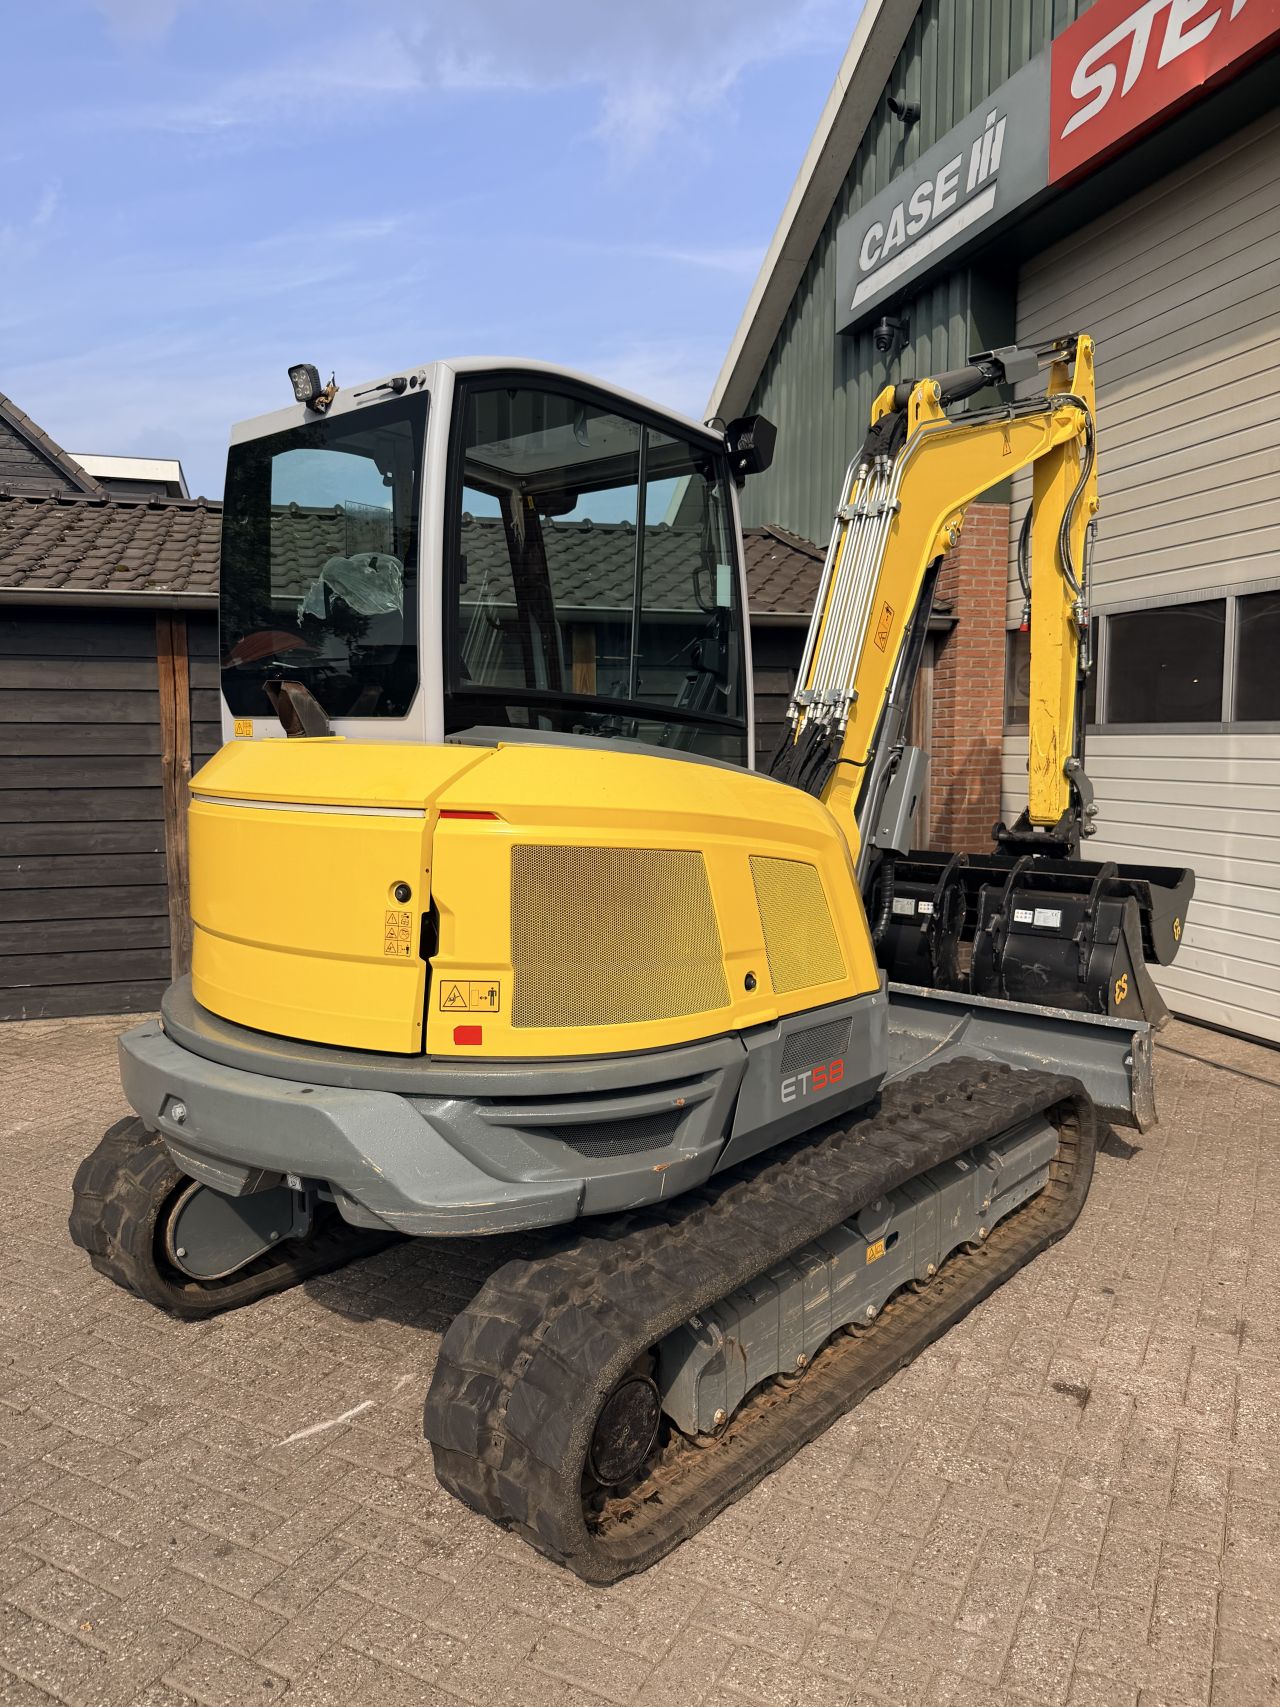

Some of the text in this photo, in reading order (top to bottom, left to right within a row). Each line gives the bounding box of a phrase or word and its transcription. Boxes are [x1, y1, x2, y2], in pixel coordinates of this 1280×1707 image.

[1060, 0, 1247, 140] STE
[858, 152, 964, 273] CASE
[781, 1058, 844, 1103] ET58
